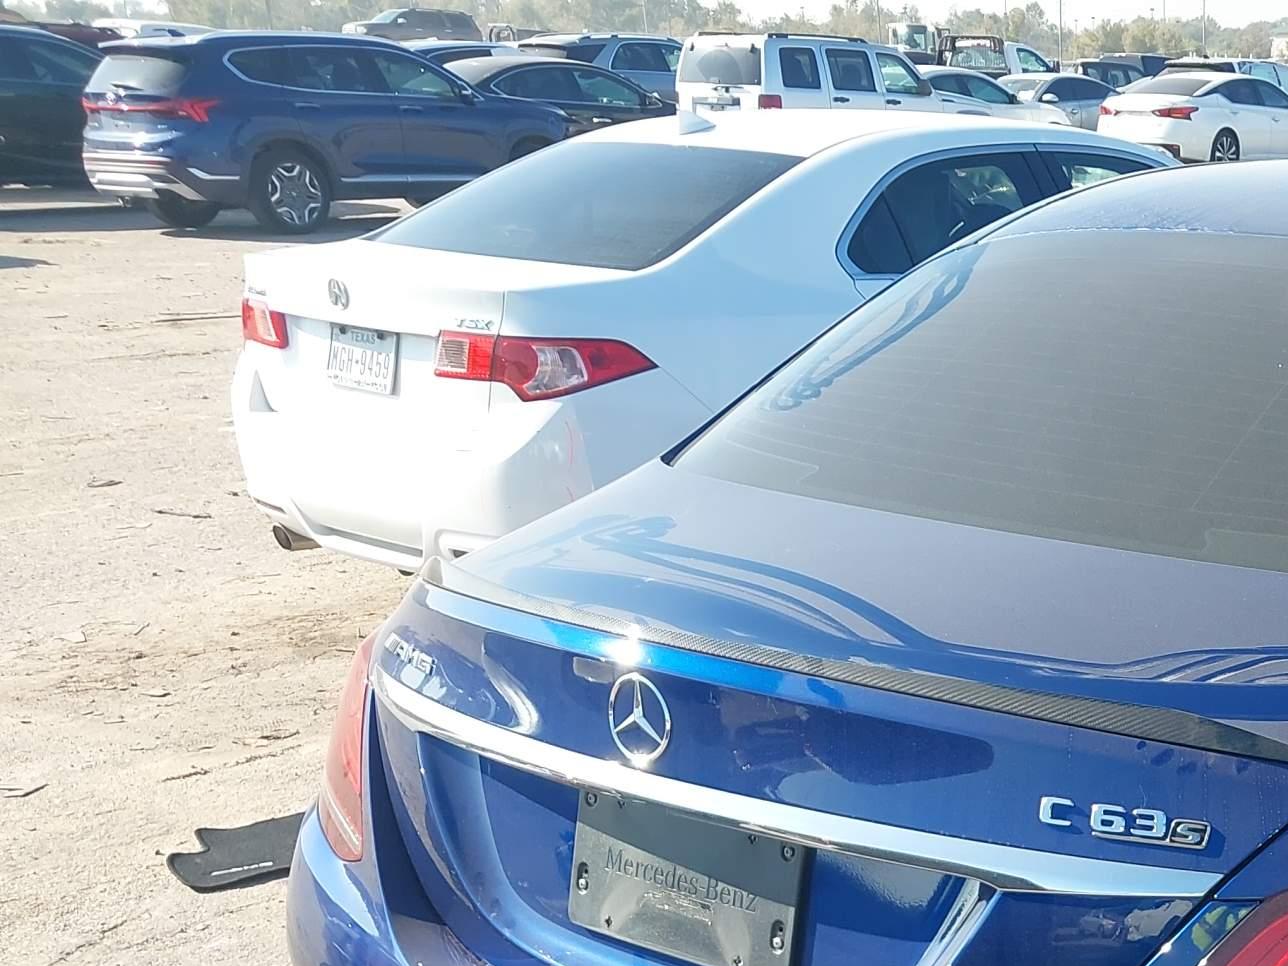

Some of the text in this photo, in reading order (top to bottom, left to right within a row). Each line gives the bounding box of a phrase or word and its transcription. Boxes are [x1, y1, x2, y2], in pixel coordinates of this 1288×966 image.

[350, 330, 376, 345] TEXAS
[393, 638, 434, 675] AMG
[1038, 795, 1076, 827] C
[604, 845, 761, 914] Mercedes-Benz
